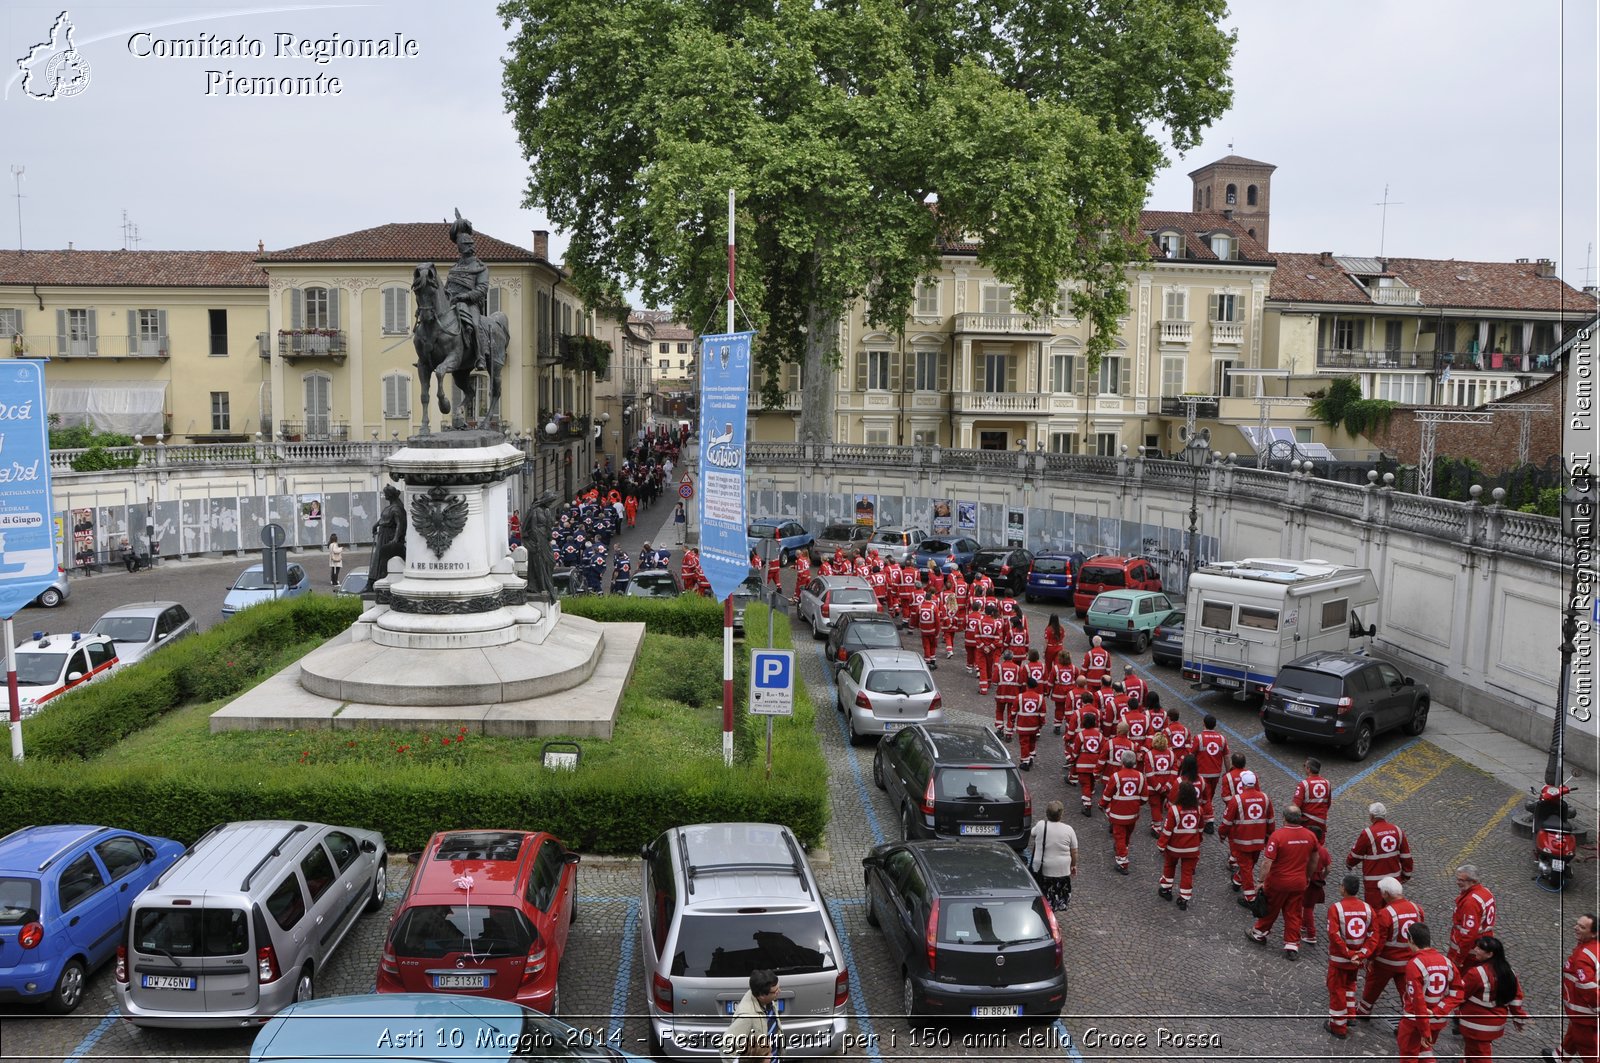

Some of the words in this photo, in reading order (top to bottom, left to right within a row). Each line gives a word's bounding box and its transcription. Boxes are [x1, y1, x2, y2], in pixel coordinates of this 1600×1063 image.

[3, 516, 10, 524] di
[12, 516, 41, 525] Giugno
[429, 562, 464, 570] UMBERTO
[763, 659, 783, 684] P
[148, 976, 159, 986] DW
[162, 976, 190, 988] 746NV
[440, 976, 450, 986] DF
[454, 976, 484, 986] 313XR
[977, 1007, 988, 1016] ED
